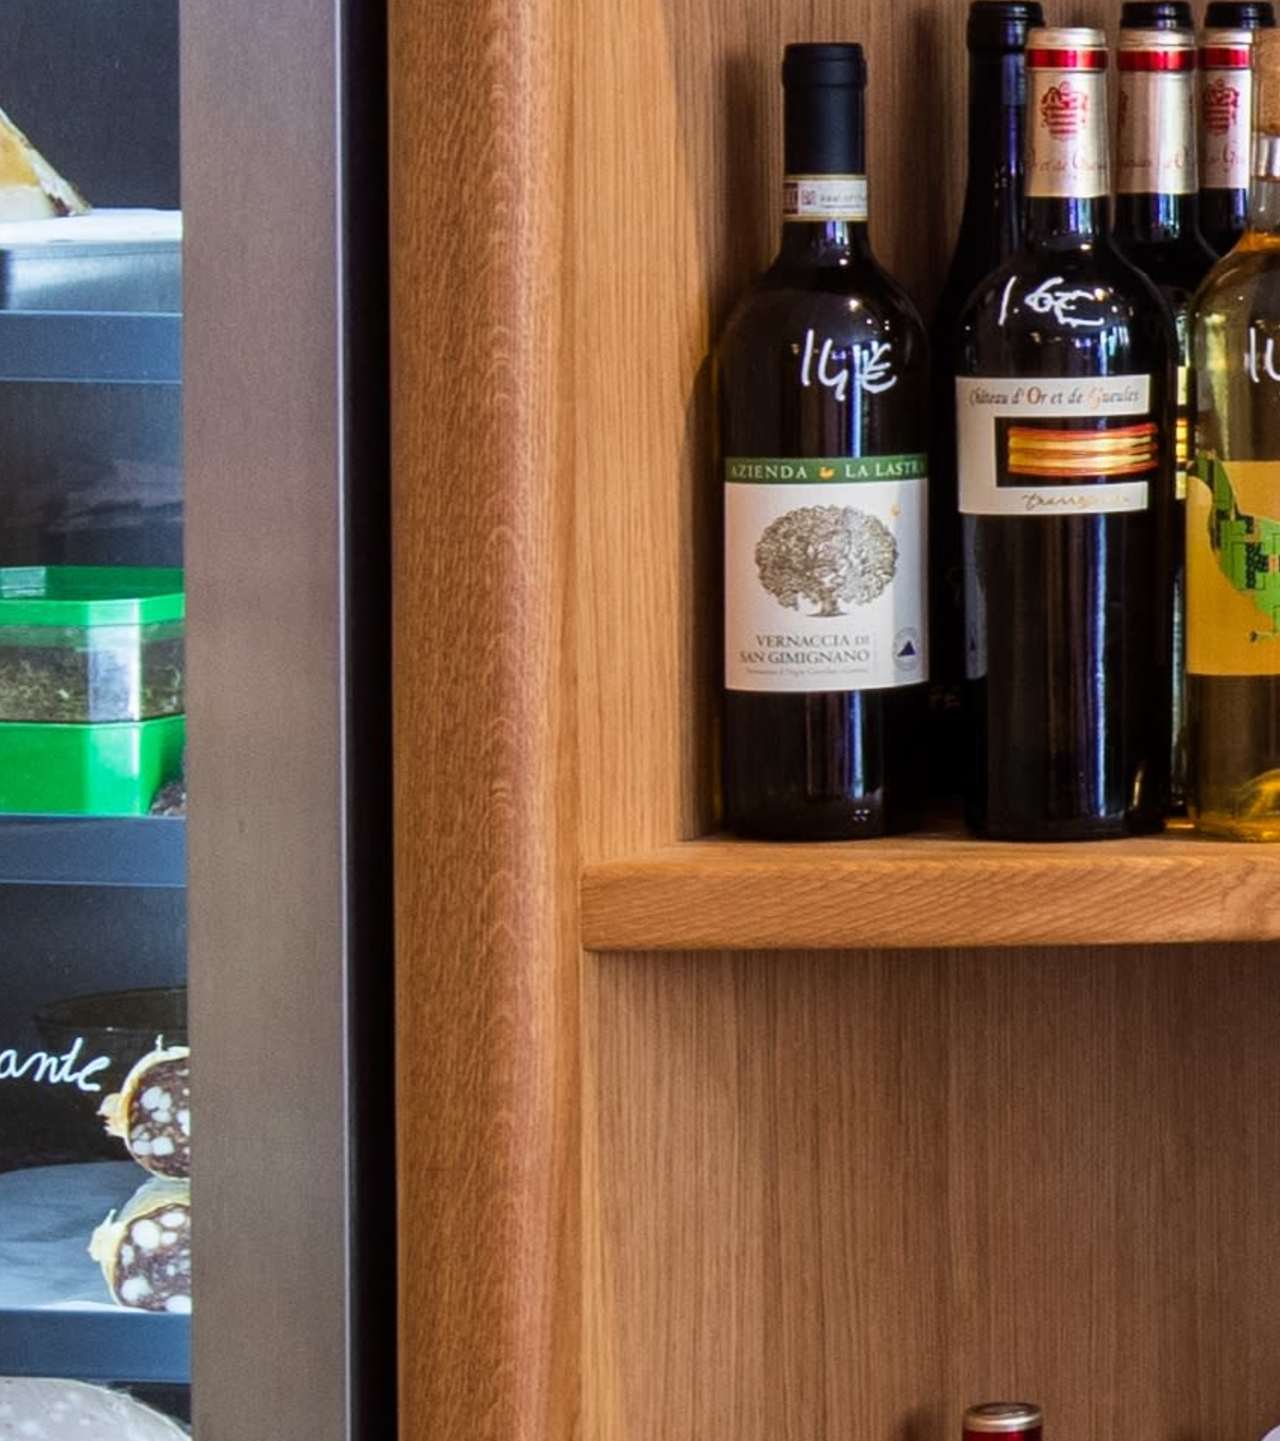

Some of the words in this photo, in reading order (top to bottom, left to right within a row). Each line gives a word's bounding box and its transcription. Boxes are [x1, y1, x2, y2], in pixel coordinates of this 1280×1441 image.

[1050, 390, 1064, 405] et
[1069, 388, 1084, 404] de
[731, 466, 808, 481] AZIENDA
[844, 465, 869, 479] LA
[755, 633, 851, 649] VERNACCIA
[739, 650, 766, 666] SAN
[768, 649, 871, 665] GIMIGNANO
